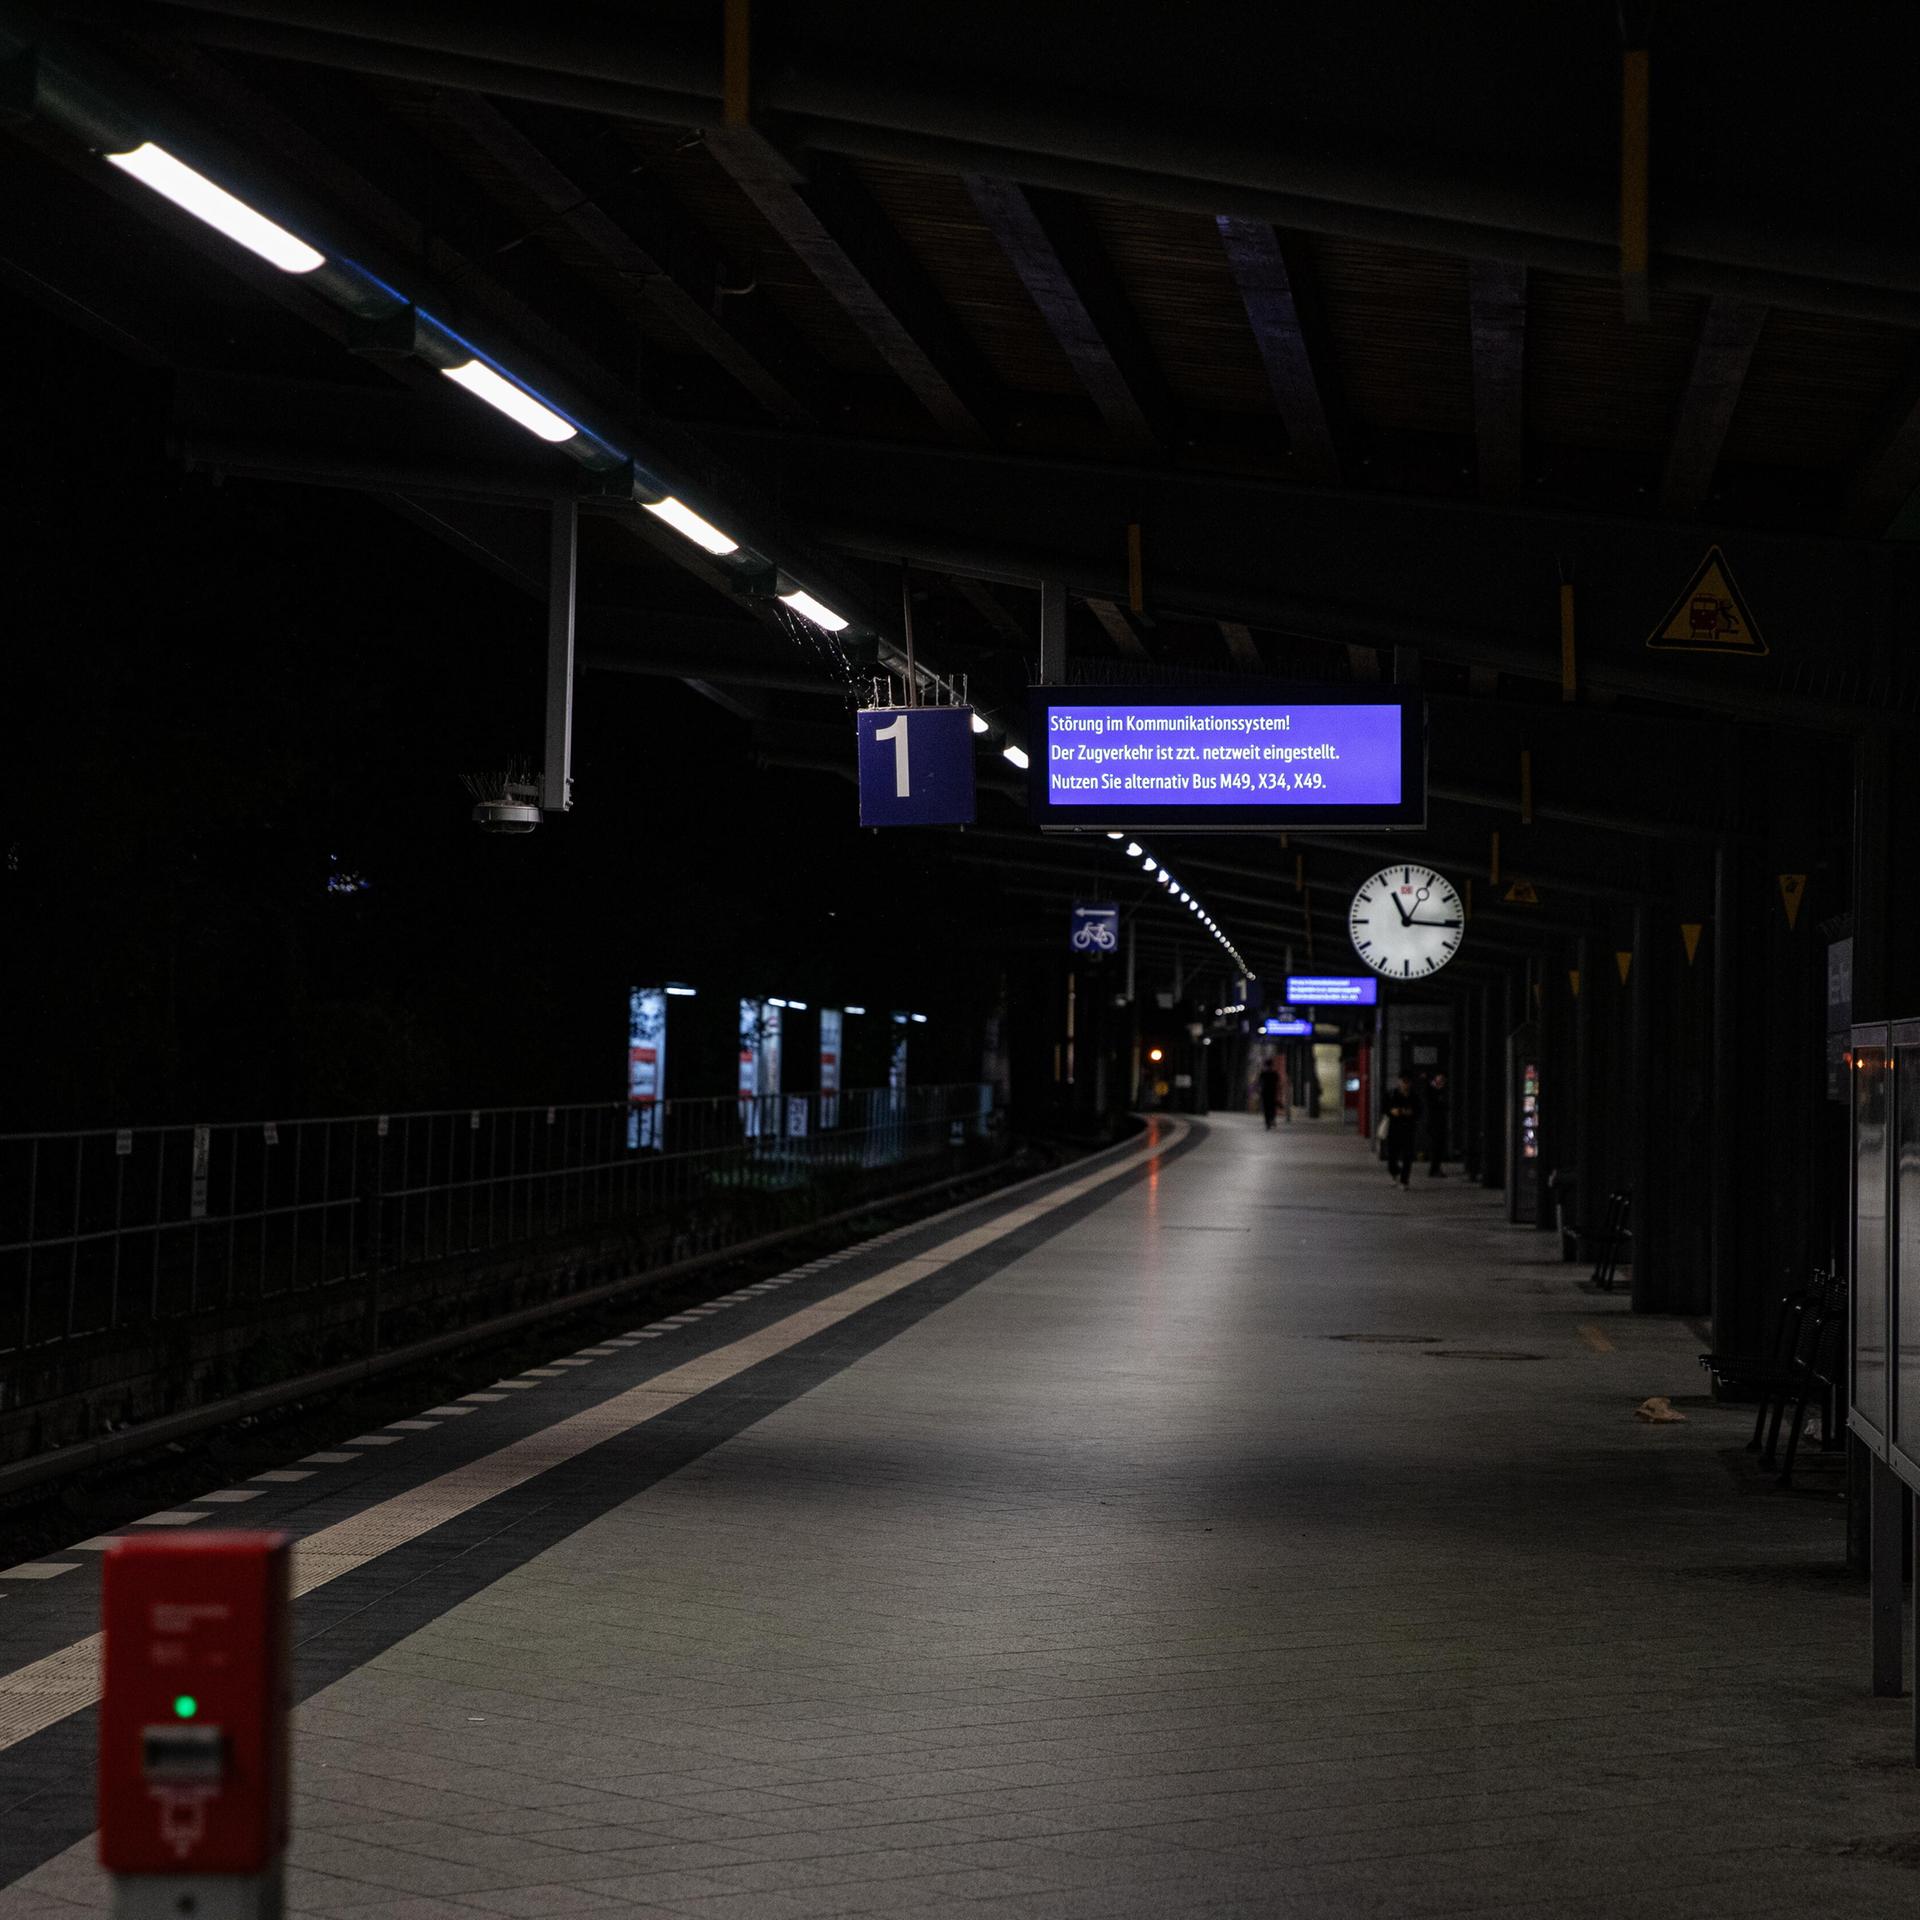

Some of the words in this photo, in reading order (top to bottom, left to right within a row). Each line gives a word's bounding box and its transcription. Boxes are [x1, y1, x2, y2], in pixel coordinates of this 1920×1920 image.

[1050, 715, 1103, 733] Störung
[1106, 715, 1123, 731] im
[1126, 715, 1290, 733] Kommunikationssystem!
[875, 715, 910, 797] 1
[1051, 745, 1075, 761] Der
[1077, 744, 1154, 763] Zugverkehr
[1156, 744, 1173, 760] ist
[1176, 746, 1200, 760] zzt.
[1202, 744, 1261, 760] netzweit
[1262, 744, 1340, 763] eingestellt.
[1051, 774, 1099, 789] Nutzen
[1101, 773, 1122, 789] Sie
[1124, 773, 1189, 789] alternativ
[1192, 773, 1217, 788] Bus
[1219, 773, 1255, 791] M49,
[1258, 773, 1290, 791] X34,
[1293, 773, 1327, 788] X49.
